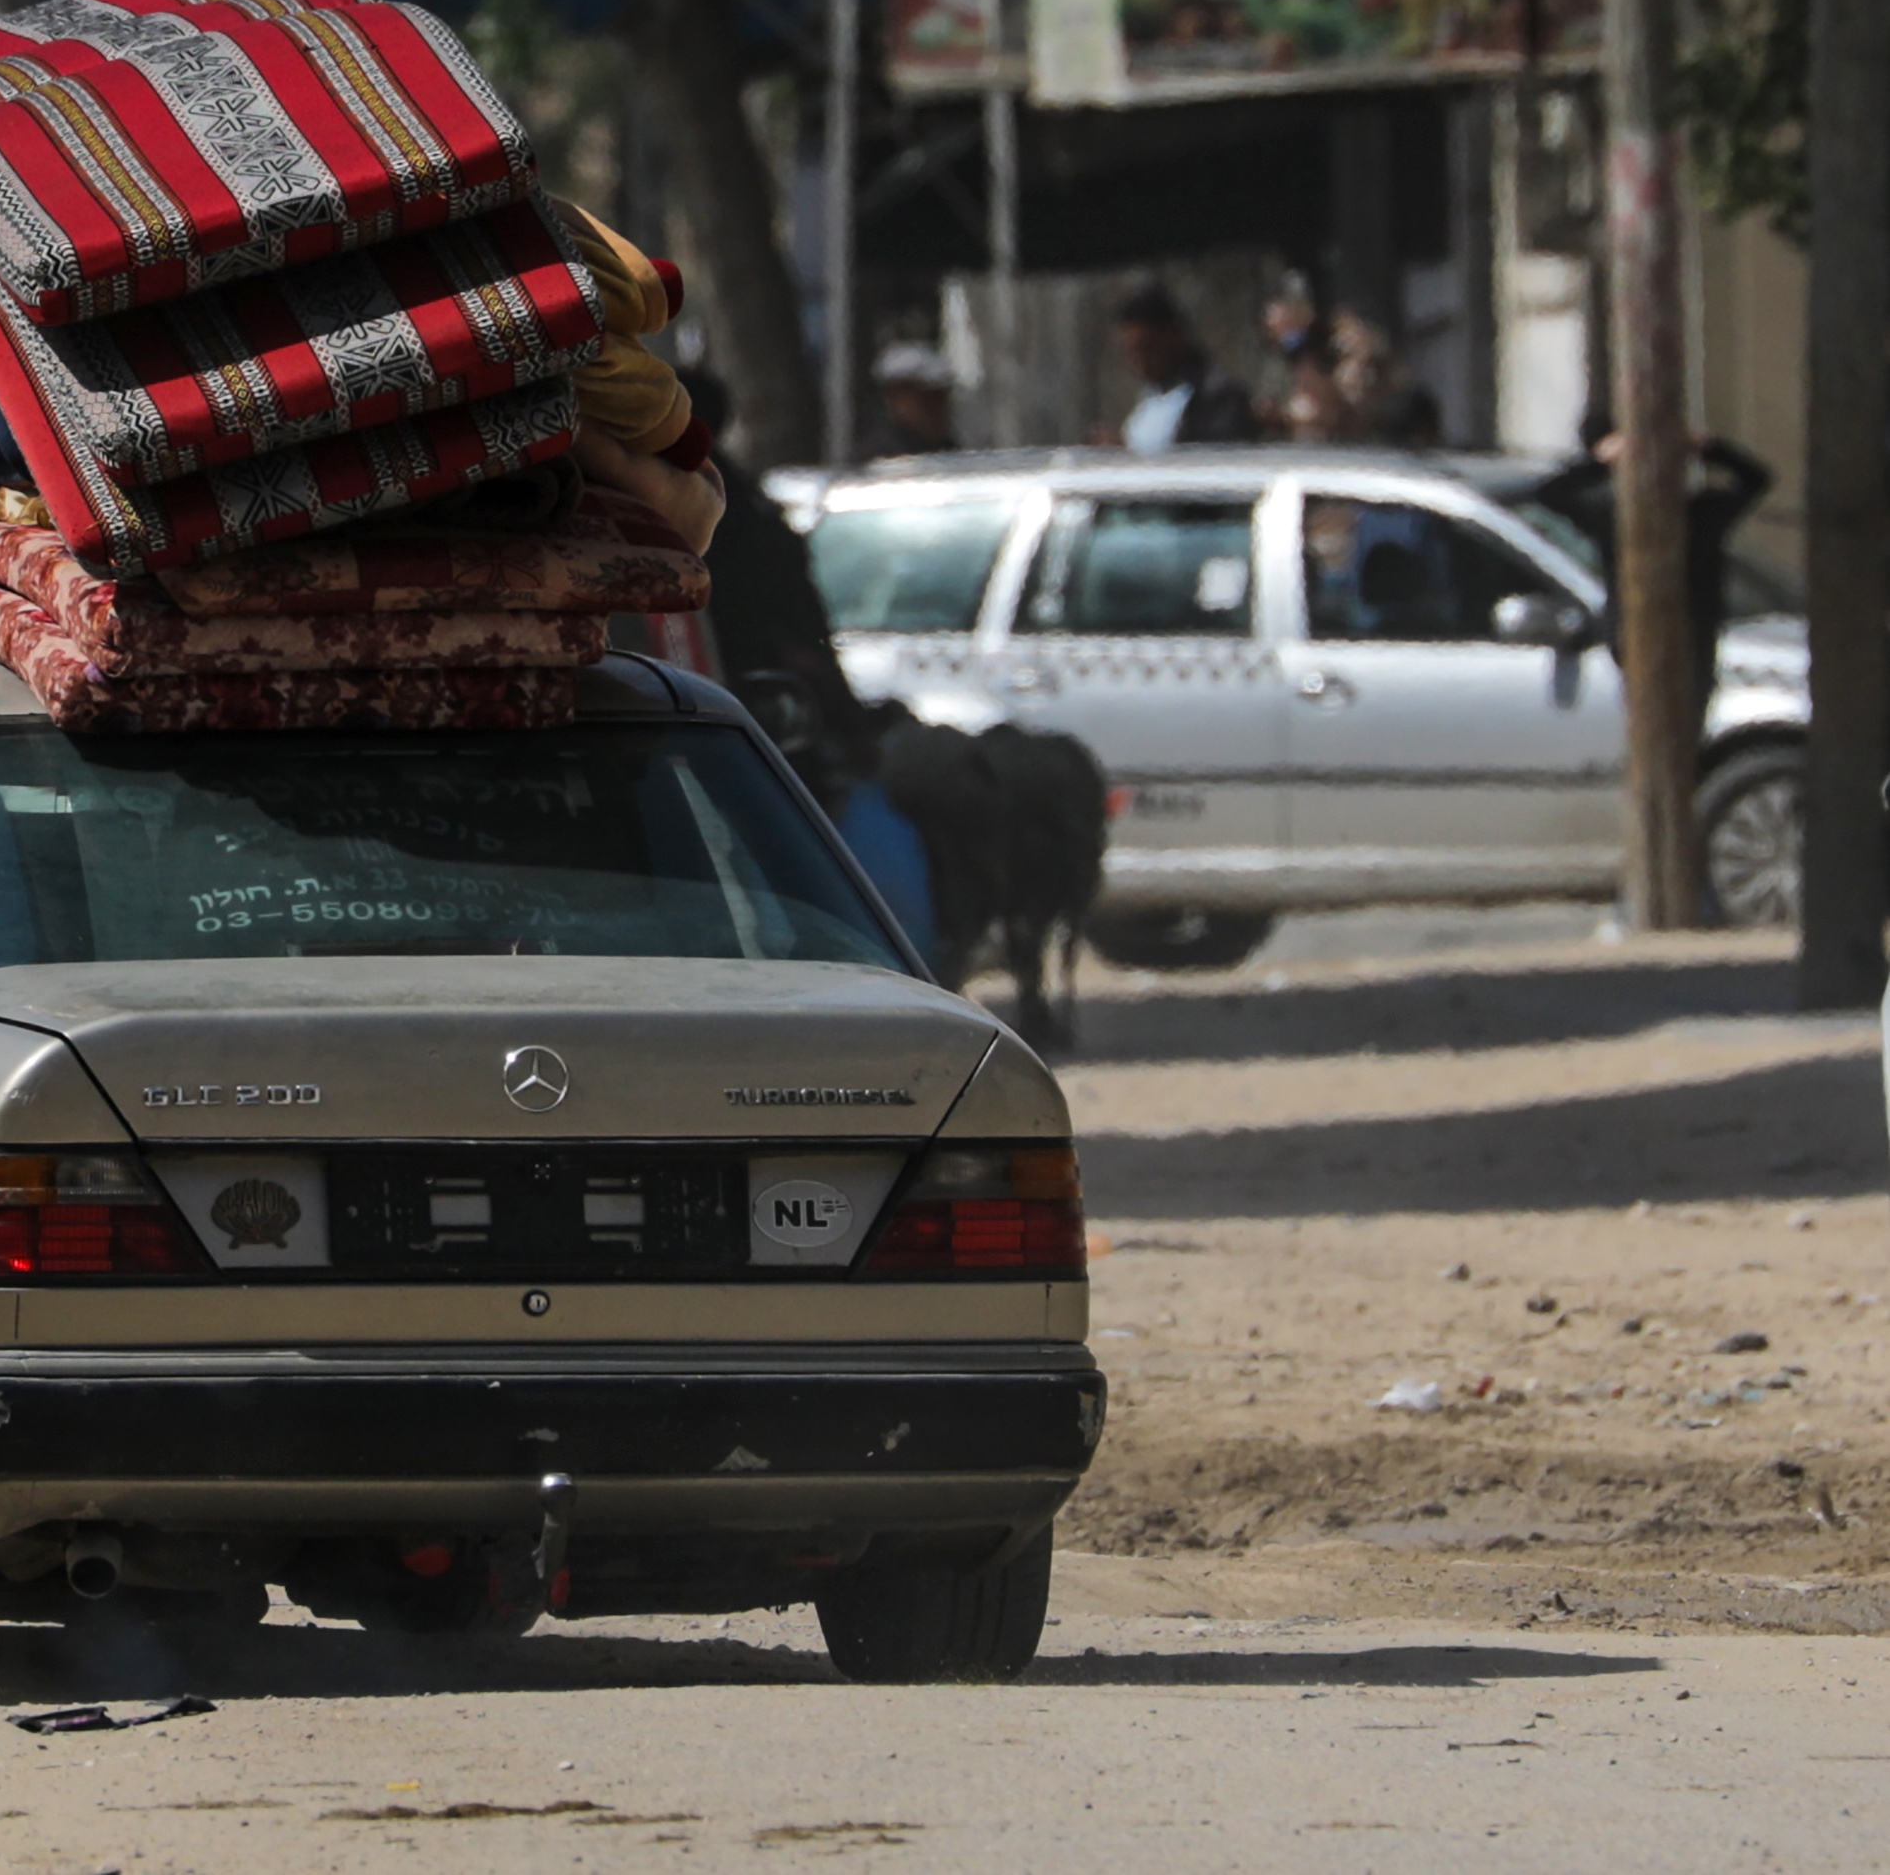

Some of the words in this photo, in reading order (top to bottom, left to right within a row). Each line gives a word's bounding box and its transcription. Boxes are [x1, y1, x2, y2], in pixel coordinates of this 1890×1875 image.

[367, 868, 409, 892] 33
[188, 884, 272, 915] חולון
[195, 899, 489, 933] 03-5508098
[722, 1086, 915, 1107] TURBODIESEL
[773, 1199, 829, 1228] NL
